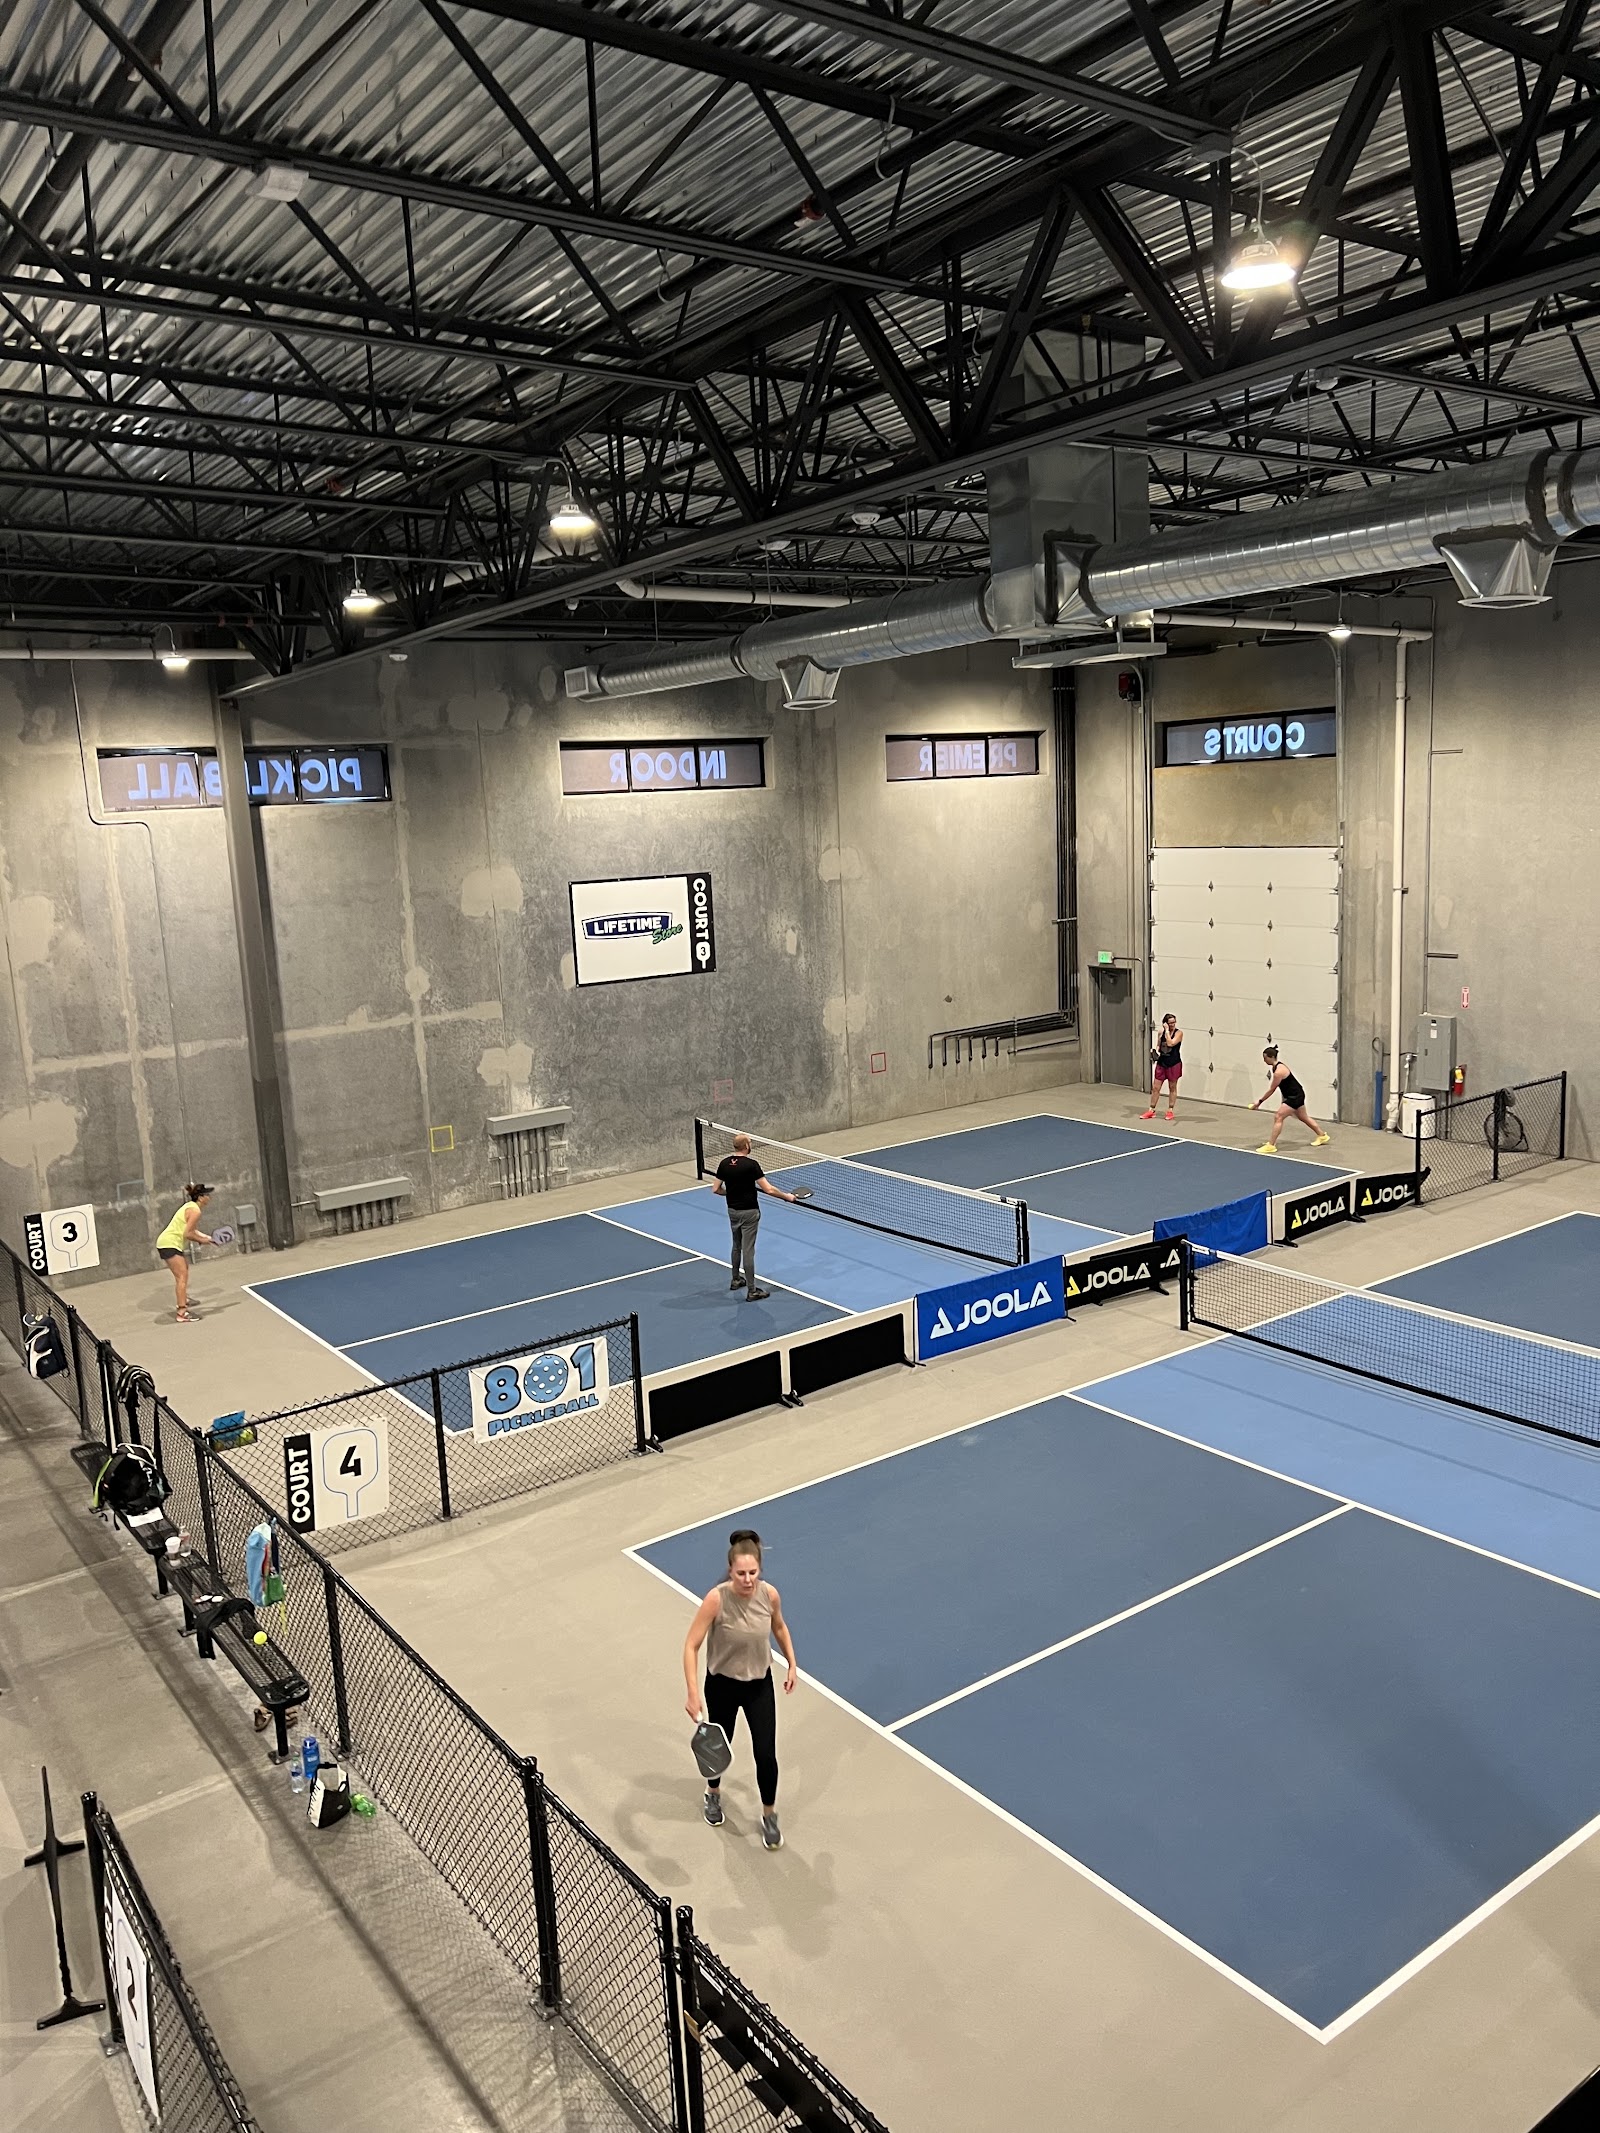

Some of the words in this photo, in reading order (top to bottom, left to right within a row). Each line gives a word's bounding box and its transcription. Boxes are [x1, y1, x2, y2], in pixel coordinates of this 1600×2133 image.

[693, 878, 709, 940] COURT
[594, 916, 662, 935] LIFETIME
[652, 923, 684, 945] Store
[700, 946, 707, 956] 3
[1303, 1195, 1346, 1225] JOOLA
[26, 1222, 46, 1270] COURT
[62, 1221, 78, 1243] 3
[1081, 1262, 1152, 1293] JOOLA
[955, 1281, 1053, 1332] JOOLA
[484, 1342, 596, 1415] 801
[487, 1393, 600, 1437] PICKLEBALL
[339, 1445, 362, 1477] 4
[288, 1448, 312, 1523] COURT
